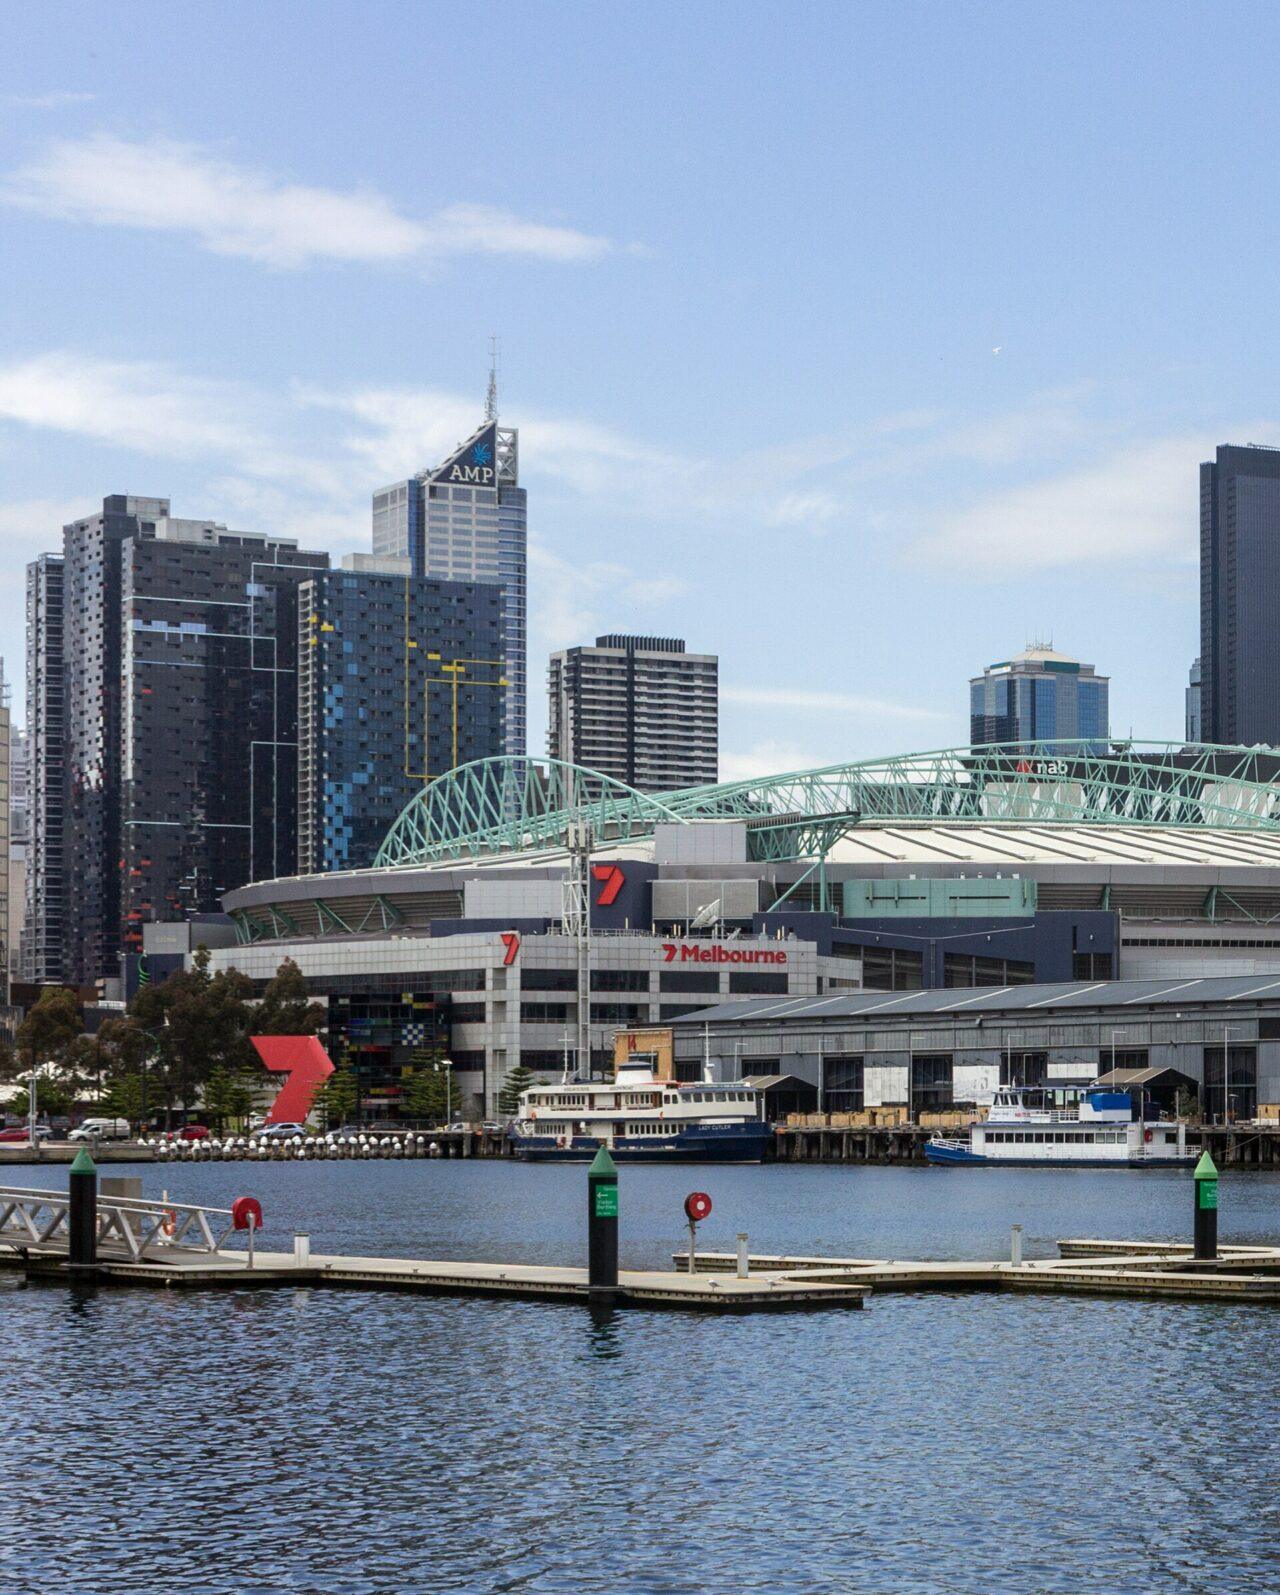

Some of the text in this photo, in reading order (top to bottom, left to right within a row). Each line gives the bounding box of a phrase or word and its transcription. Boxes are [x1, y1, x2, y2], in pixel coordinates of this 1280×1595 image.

[449, 464, 493, 483] AMP
[1037, 760, 1068, 774] nab
[591, 865, 625, 905] 7
[500, 934, 519, 965] 7
[662, 944, 787, 964] 7 Melbourne
[249, 1035, 336, 1125] 7
